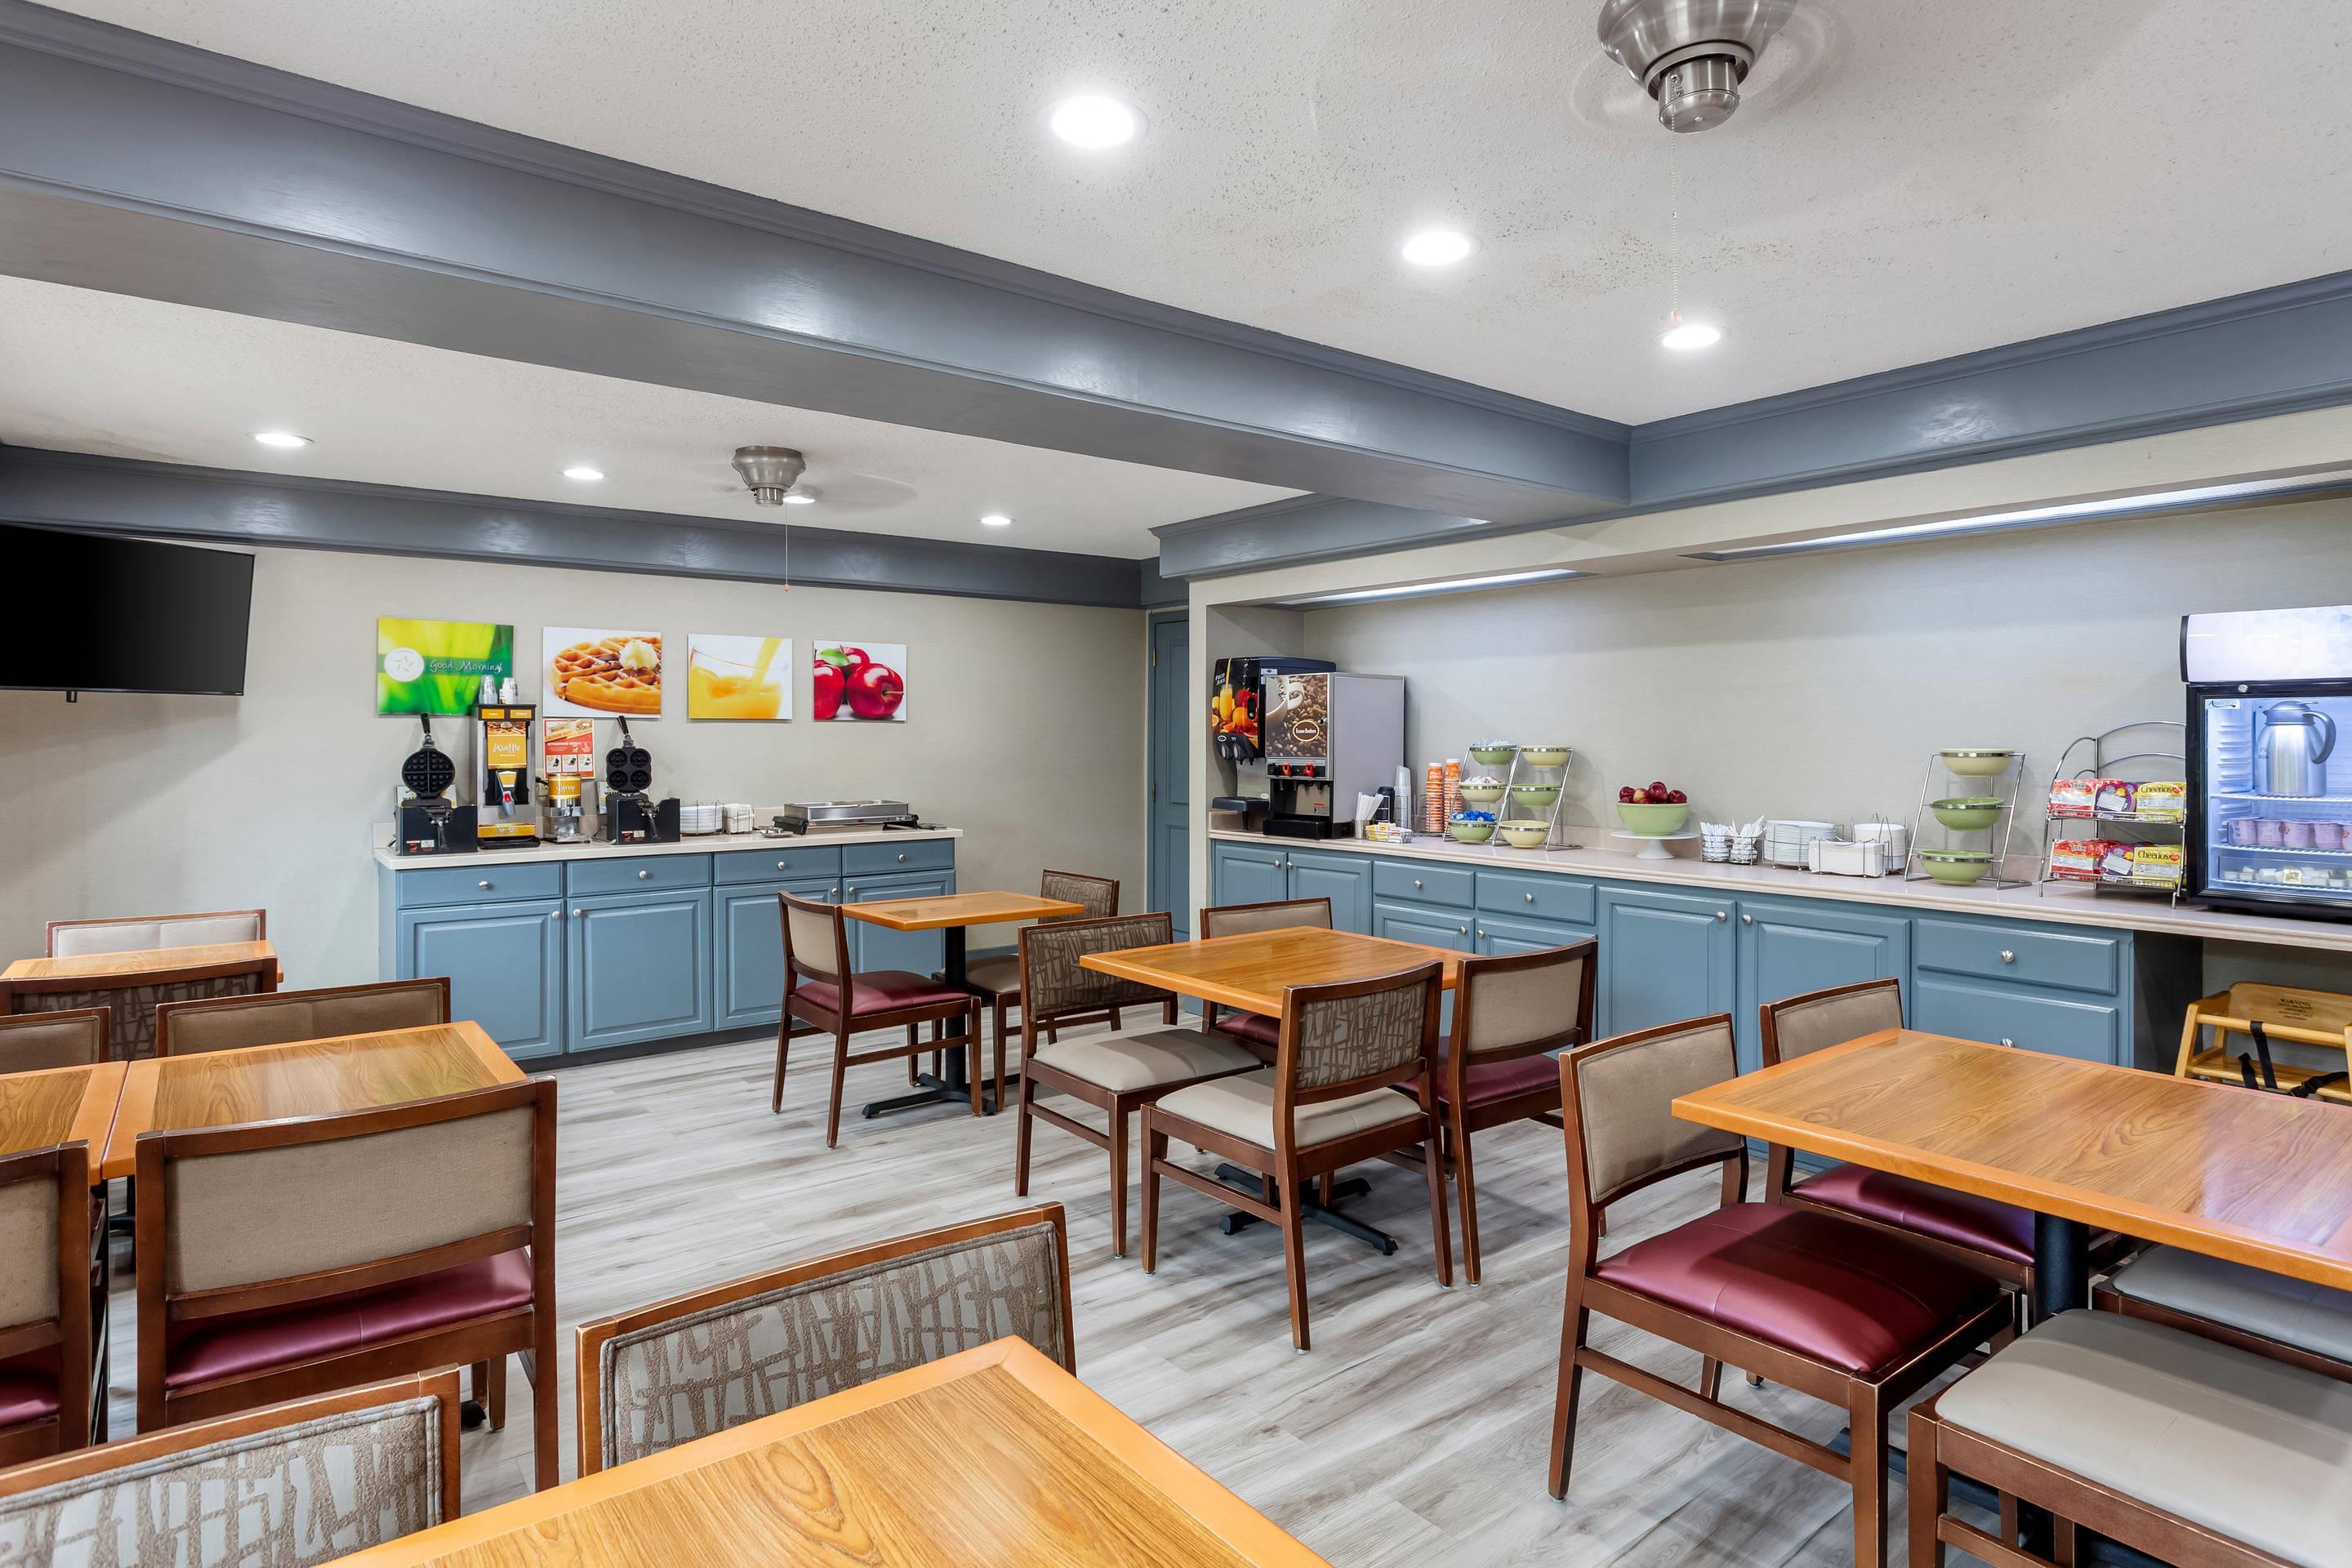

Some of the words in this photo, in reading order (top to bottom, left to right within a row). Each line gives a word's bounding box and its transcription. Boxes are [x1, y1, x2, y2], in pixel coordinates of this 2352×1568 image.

[430, 659, 453, 673] Good
[492, 742, 522, 753] Waffle
[2140, 784, 2172, 793] Cheerios
[2137, 849, 2169, 860] Cheerios
[2279, 998, 2311, 1007] WARNING
